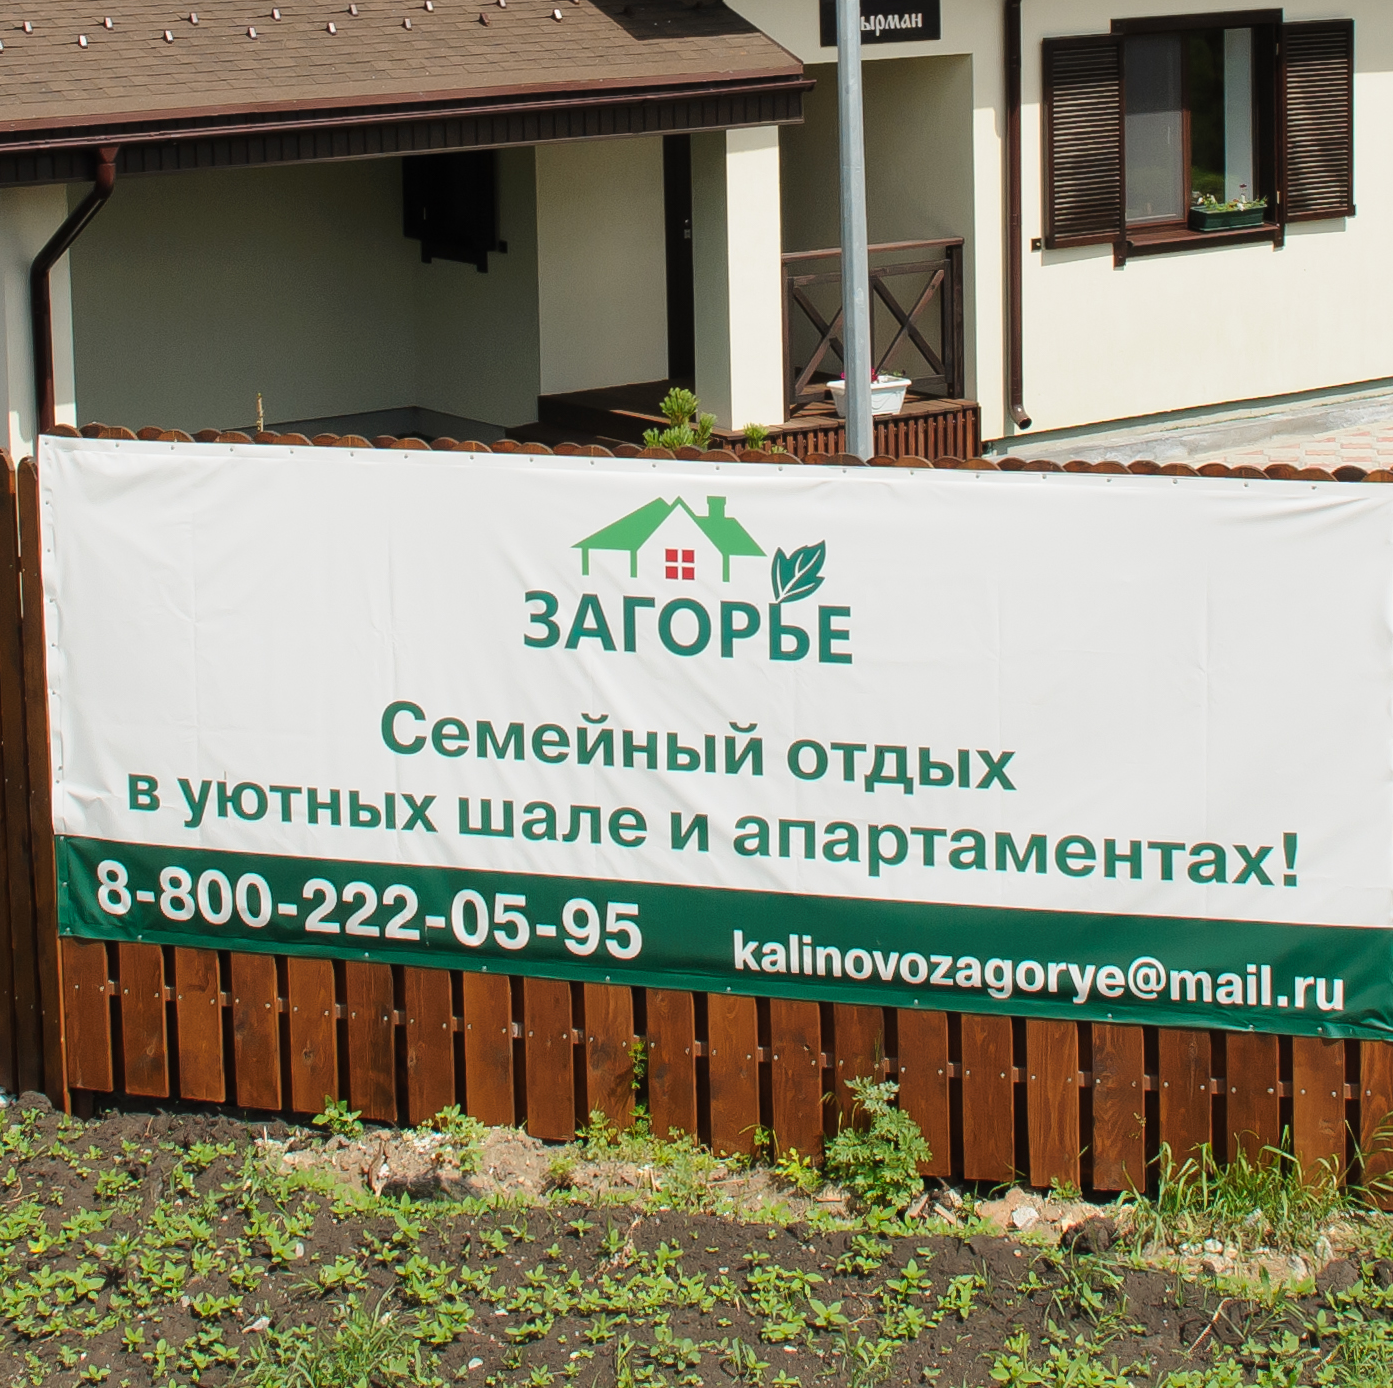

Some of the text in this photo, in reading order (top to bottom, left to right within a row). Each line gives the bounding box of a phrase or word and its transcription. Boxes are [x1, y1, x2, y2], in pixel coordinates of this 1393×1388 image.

[860, 12, 923, 36] ырман
[523, 590, 853, 665] ЗАГОРЬЕ
[381, 700, 1017, 796] Семейный отдых
[127, 773, 1300, 888] в уютных шале и апартаментах!
[96, 859, 644, 960] 8-800-222-05-95
[732, 929, 1346, 1012] kalinovozagorye@mail.ru
